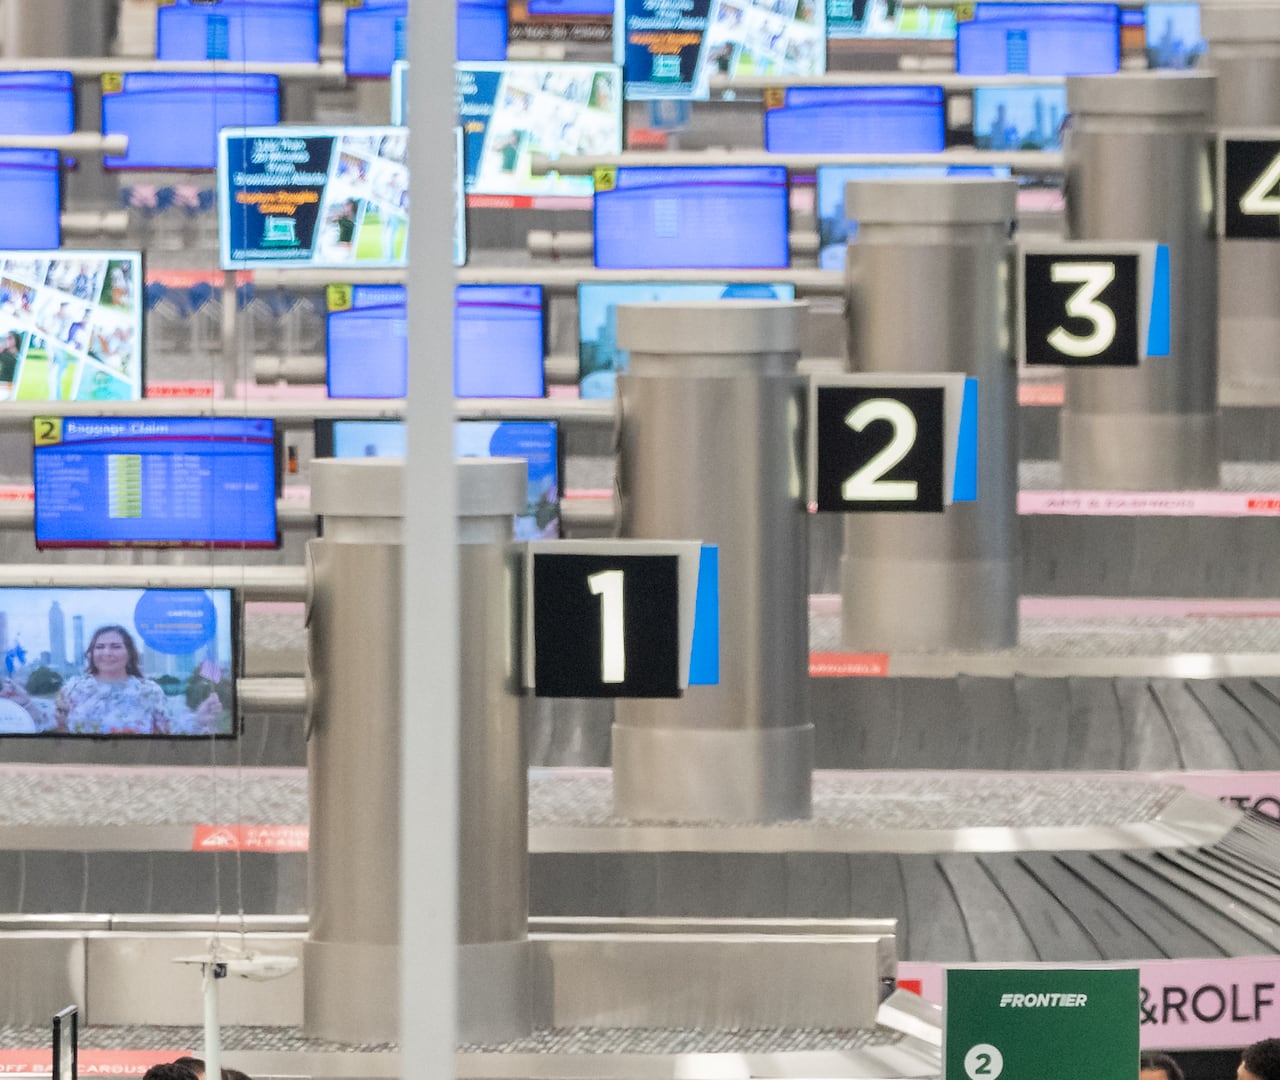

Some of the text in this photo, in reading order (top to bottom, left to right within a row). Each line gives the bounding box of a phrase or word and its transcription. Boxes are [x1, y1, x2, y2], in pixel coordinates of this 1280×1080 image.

[1046, 261, 1117, 357] 3
[41, 422, 57, 440] 2
[842, 397, 918, 501] 2
[587, 569, 626, 684] 1
[1000, 993, 1088, 1008] FRONTIER
[974, 1053, 992, 1075] 2
